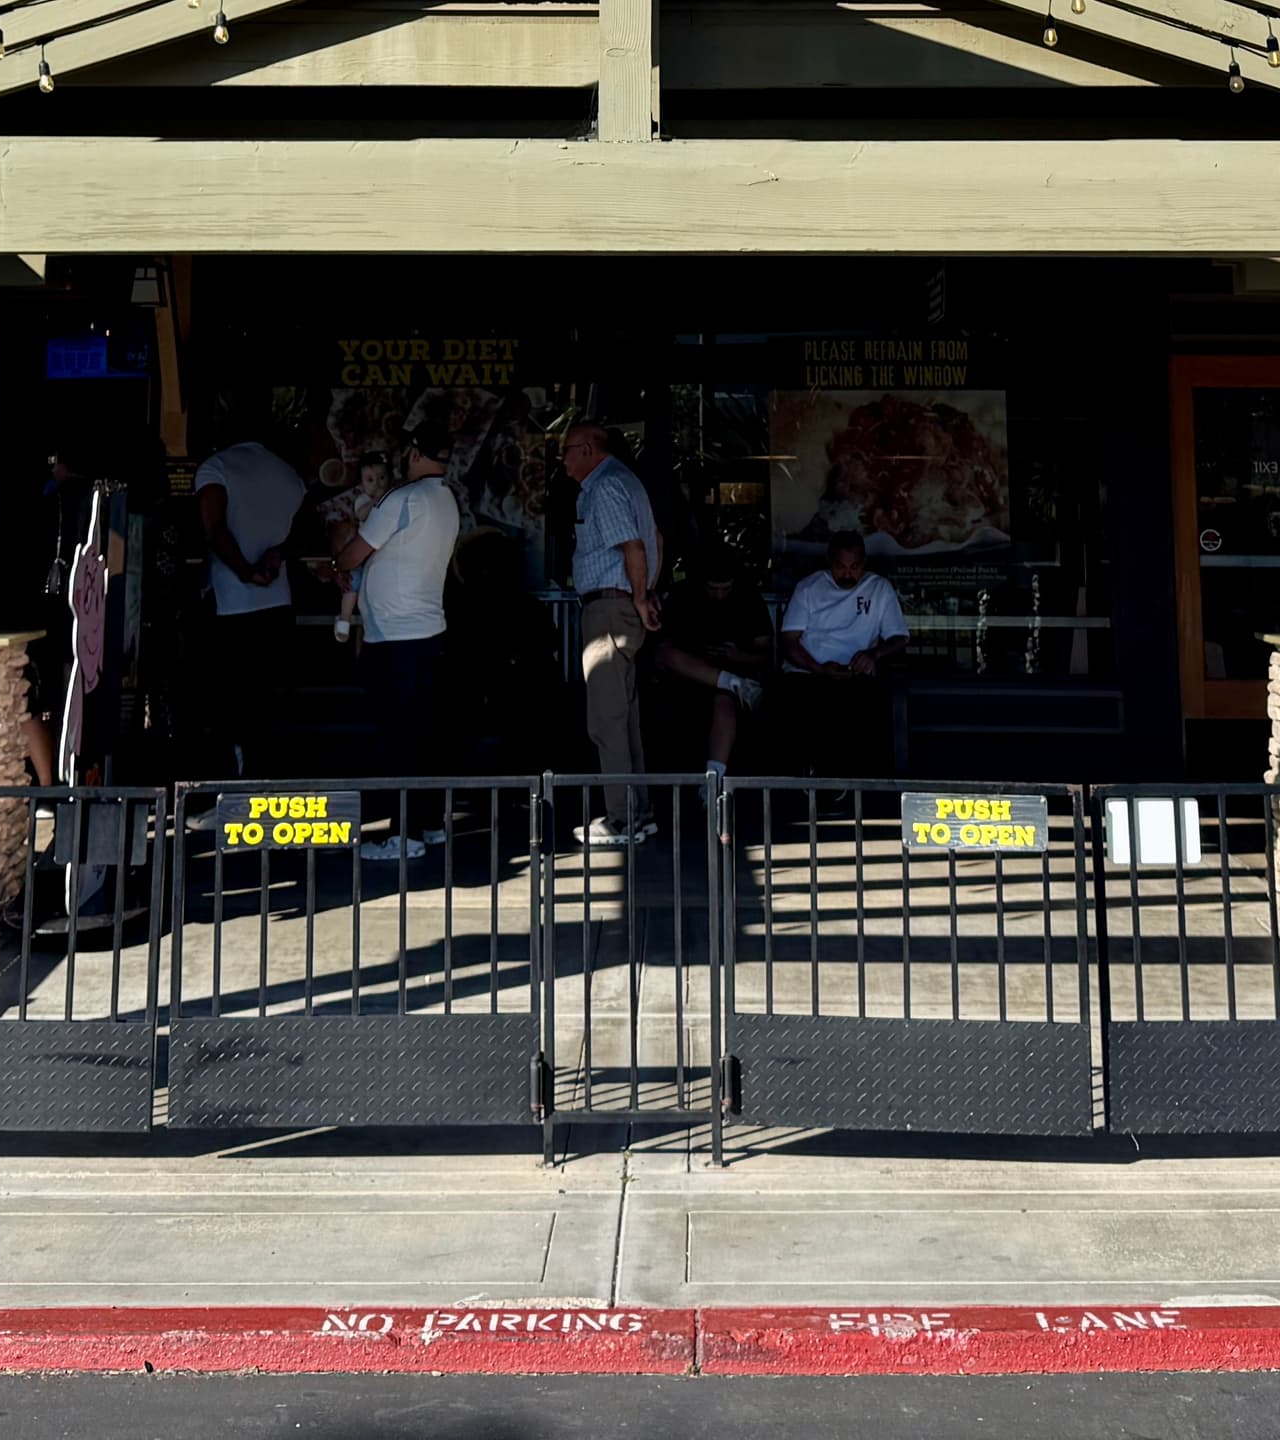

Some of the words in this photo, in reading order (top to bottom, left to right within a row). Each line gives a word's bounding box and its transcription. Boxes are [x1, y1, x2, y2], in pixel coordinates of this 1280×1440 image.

[336, 338, 431, 362] YOUR
[441, 338, 519, 362] DIET
[804, 339, 857, 361] PLEASE
[863, 339, 924, 361] REFRAIN
[931, 339, 969, 362] FROM
[340, 363, 415, 387] CAN
[425, 363, 516, 386] WAIT
[805, 365, 864, 388] LICKING
[871, 365, 897, 388] THE
[903, 365, 968, 387] WINDOW
[248, 796, 328, 819] PUSH
[935, 798, 1012, 821] PUSH
[224, 822, 265, 845] TO
[272, 821, 352, 845] OPEN
[912, 822, 951, 845] TO
[959, 824, 1036, 848] OPEN
[320, 1312, 395, 1334] NO
[420, 1312, 644, 1338] PARKING
